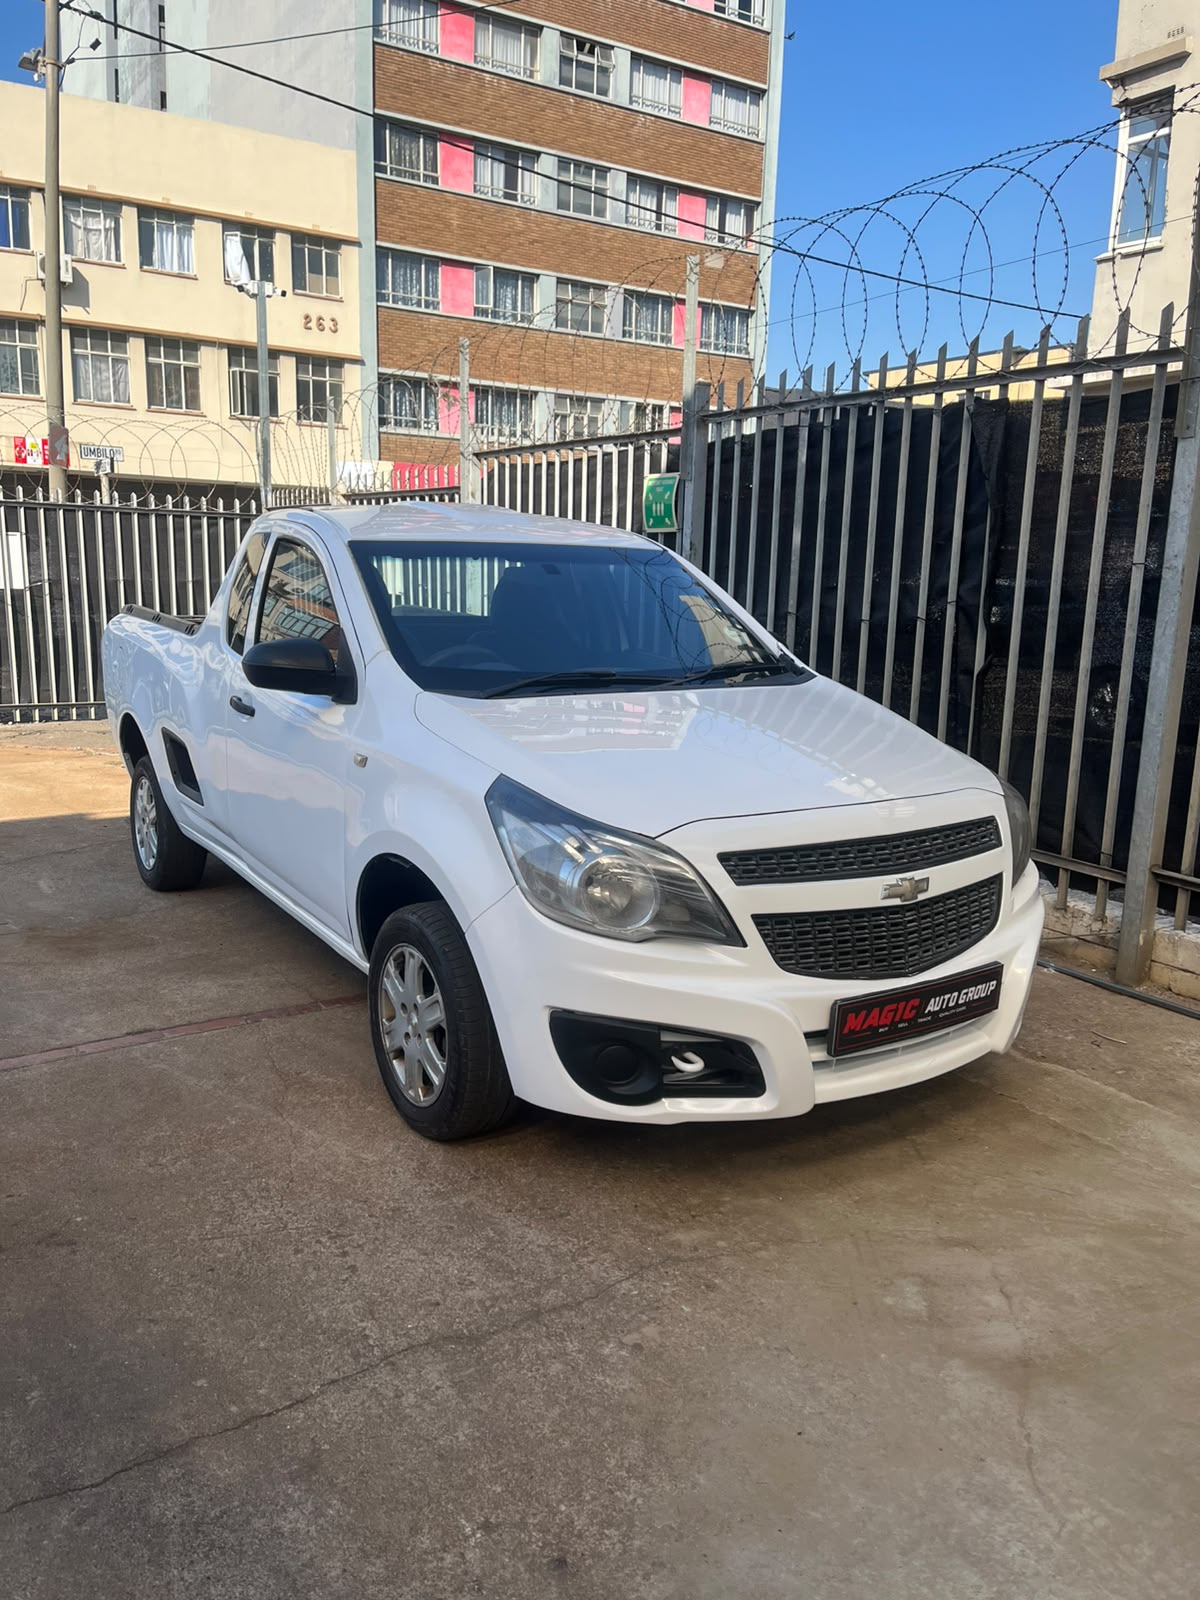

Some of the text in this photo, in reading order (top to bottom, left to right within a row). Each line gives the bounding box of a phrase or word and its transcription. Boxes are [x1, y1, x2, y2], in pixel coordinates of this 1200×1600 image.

[303, 313, 339, 334] 263
[83, 446, 115, 459] UMBILO
[842, 980, 997, 1034] MAGIC AUTO GROUP
